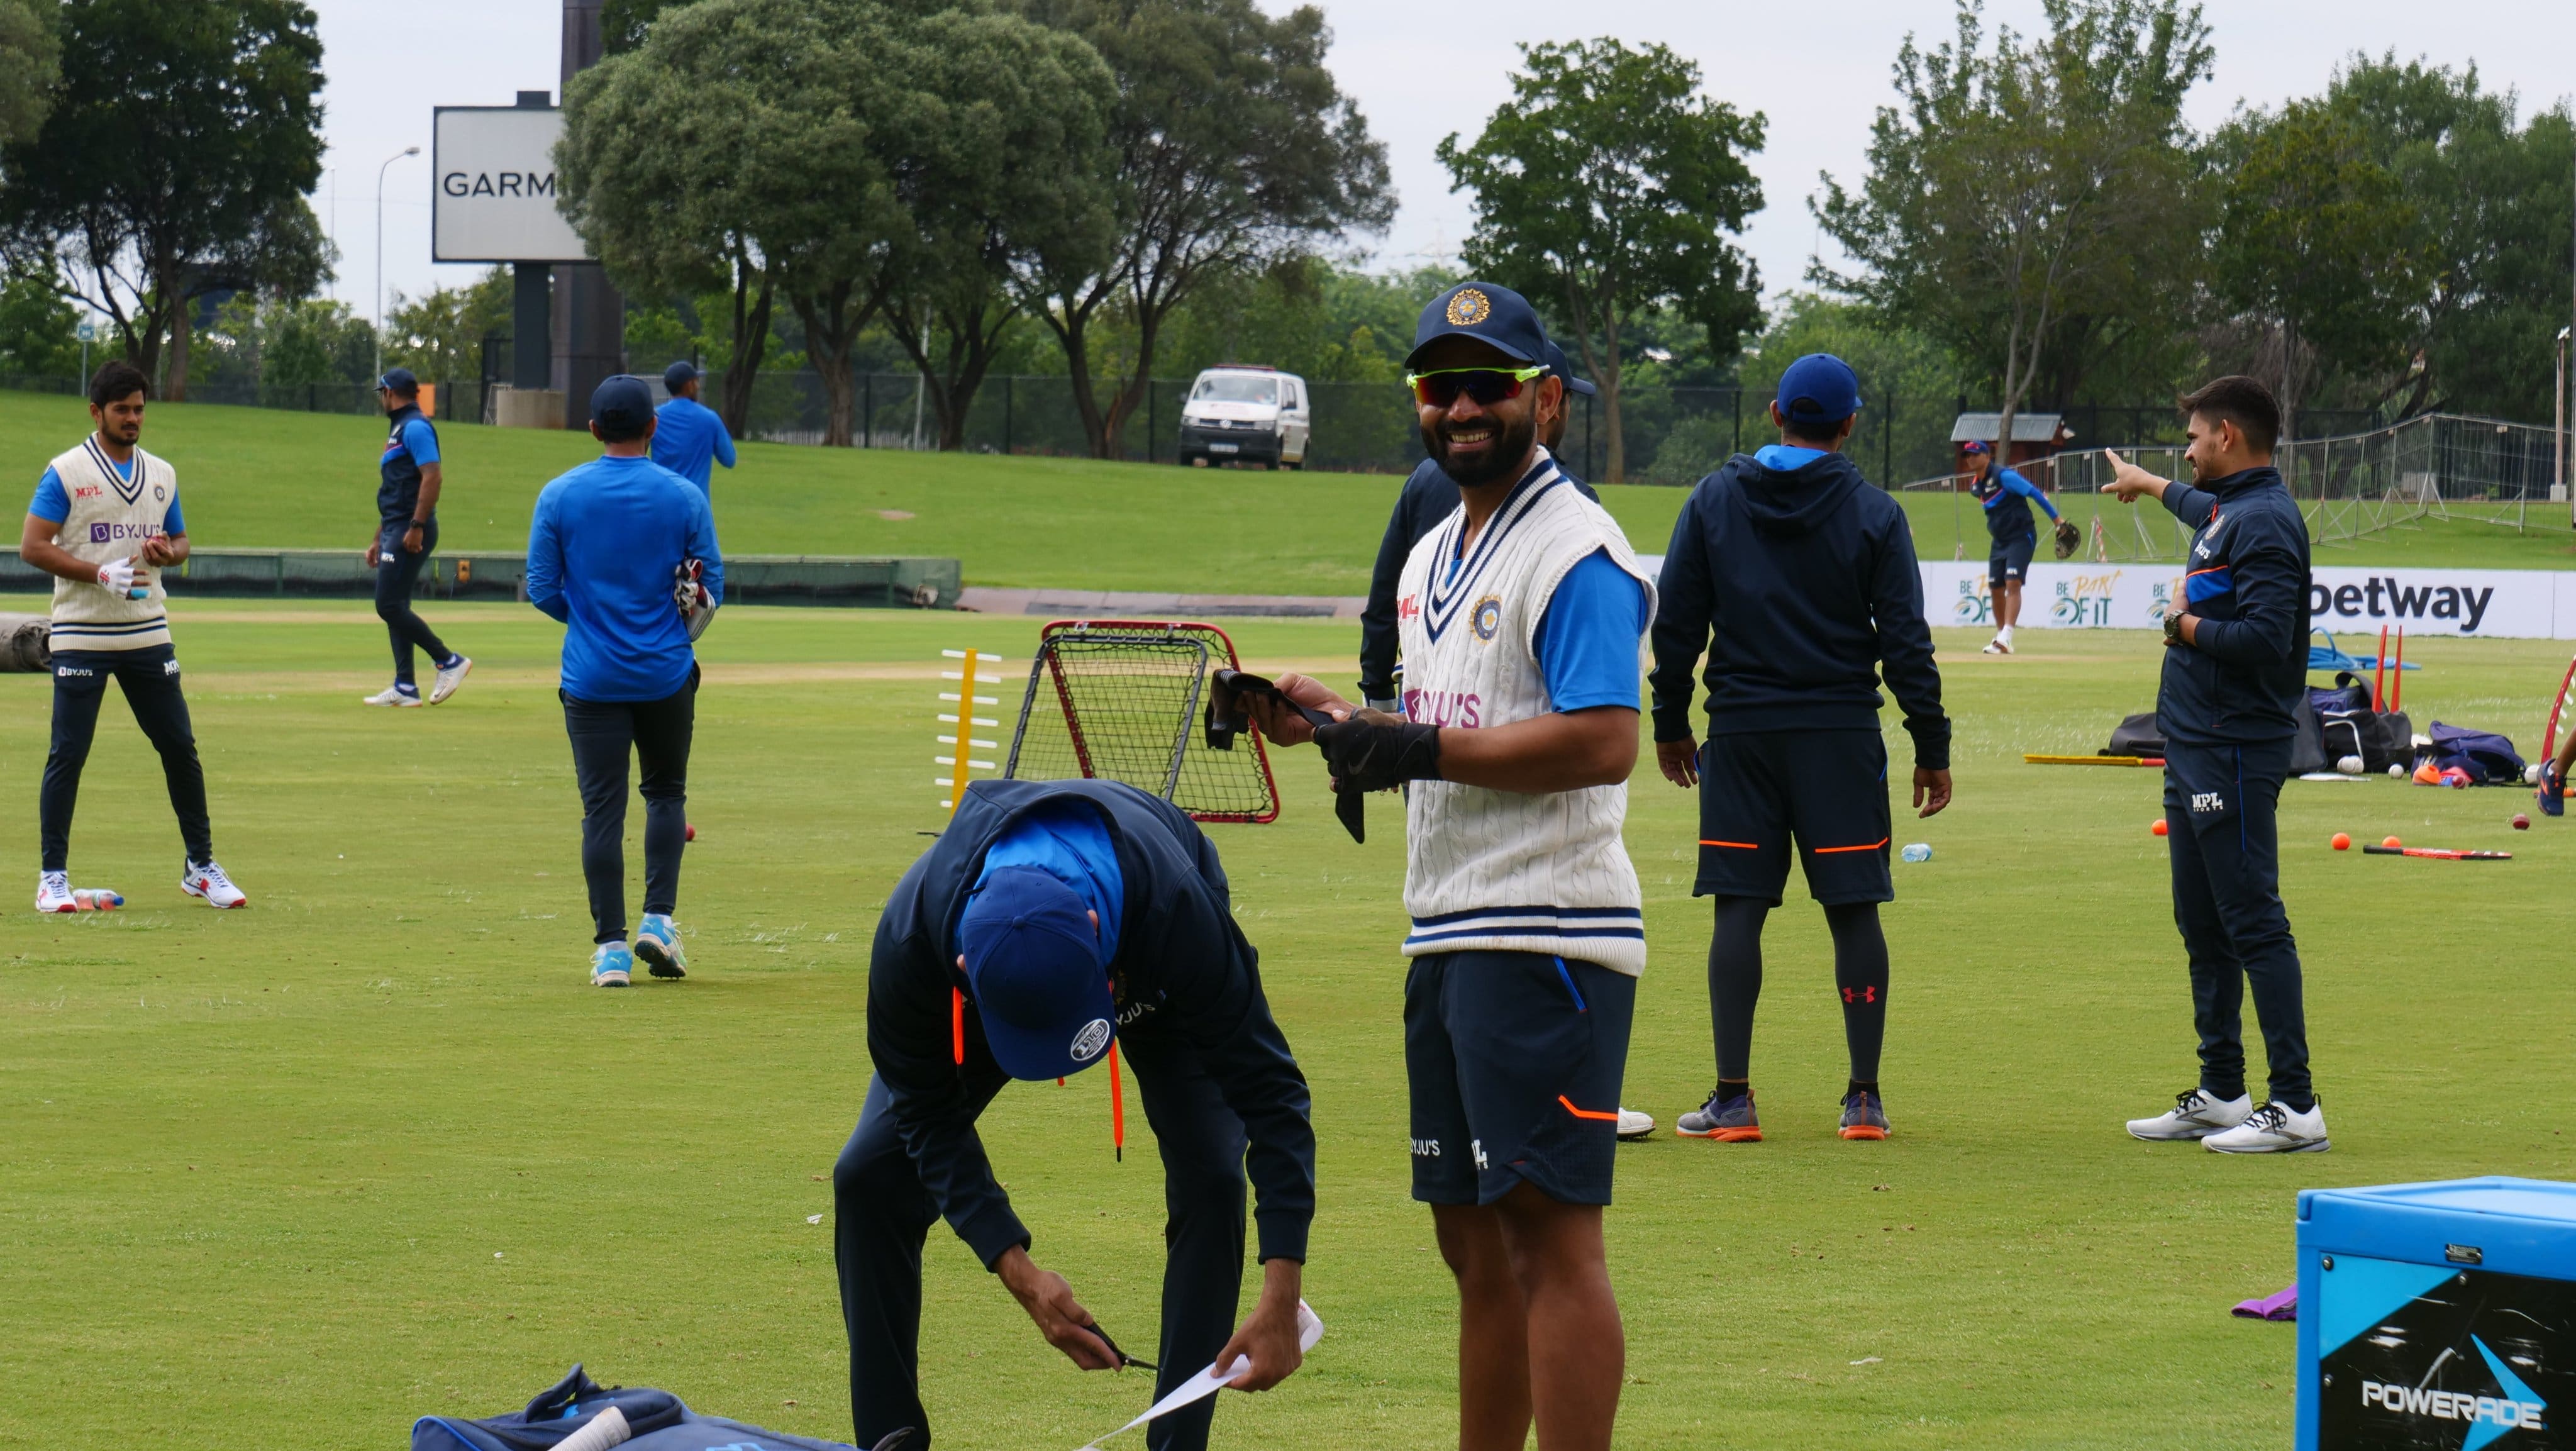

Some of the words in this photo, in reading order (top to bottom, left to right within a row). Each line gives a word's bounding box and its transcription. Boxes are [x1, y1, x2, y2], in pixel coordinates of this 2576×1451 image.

[1960, 580, 1972, 594] BE
[2056, 581, 2068, 596] BE
[2153, 584, 2166, 597] BE
[2311, 573, 2494, 632] betway
[2191, 792, 2223, 809] MPL
[1115, 1002, 1156, 1026] YJU'S
[2362, 1381, 2543, 1431] POWERADE
